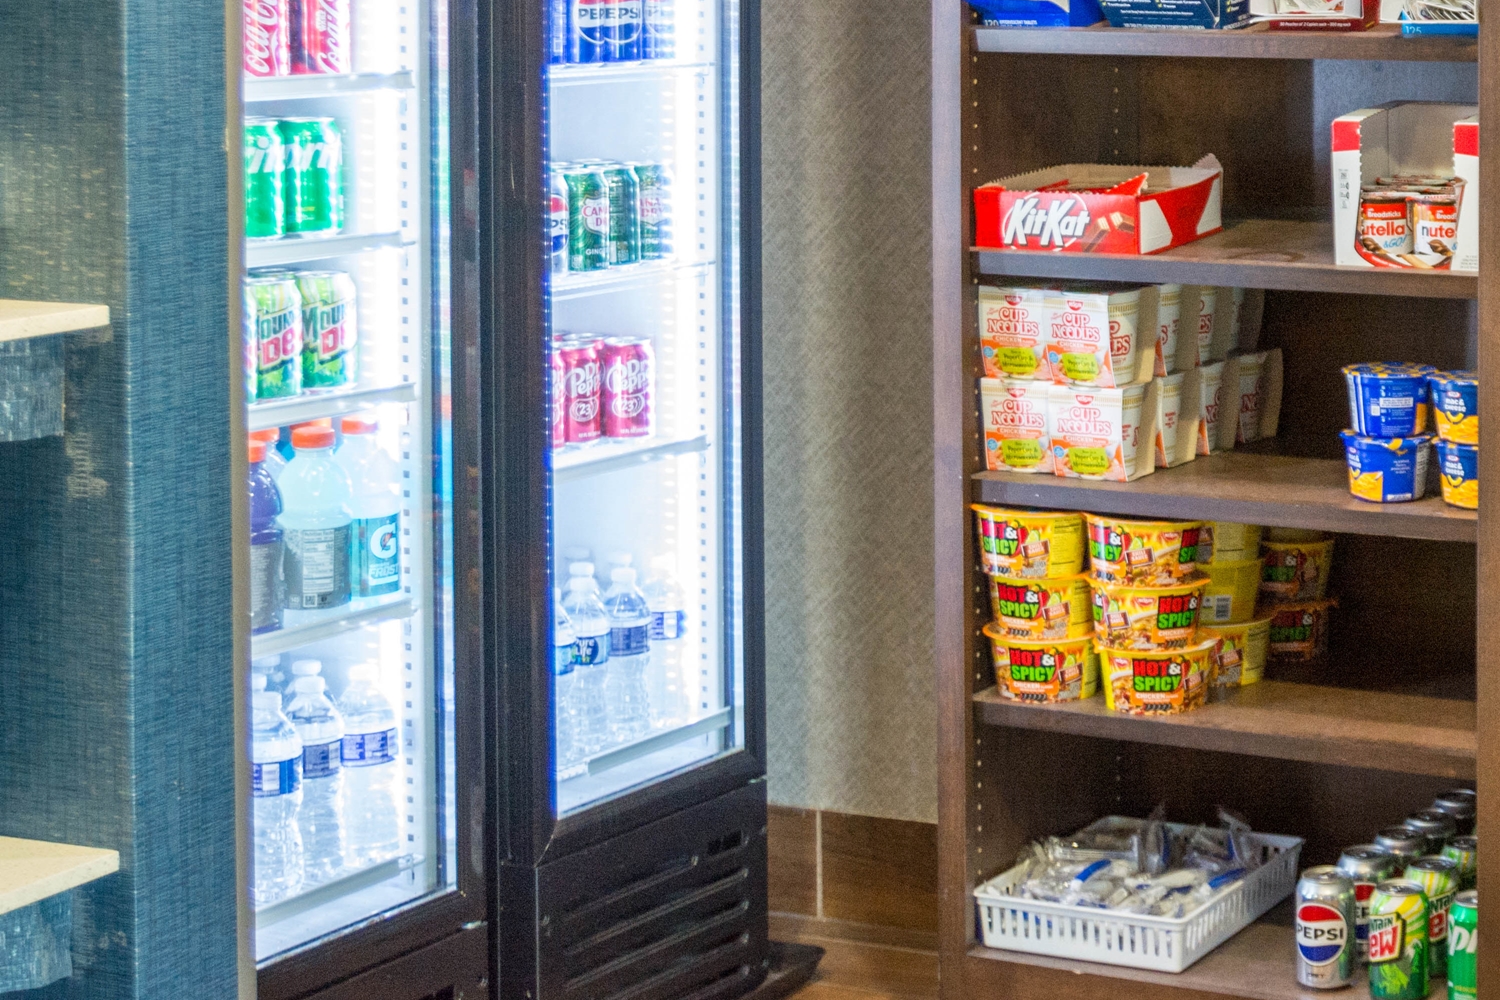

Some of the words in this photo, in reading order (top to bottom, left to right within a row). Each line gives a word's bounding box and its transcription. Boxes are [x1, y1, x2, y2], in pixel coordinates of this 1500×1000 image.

[1004, 198, 1090, 246] KitKat
[999, 307, 1028, 321] CUP
[1062, 313, 1090, 327] CUP
[987, 319, 1039, 336] NOODLES
[1052, 324, 1100, 342] NOODLES
[1009, 648, 1043, 667] HOT
[1041, 654, 1055, 666] &
[1011, 665, 1055, 682] SPICY
[1133, 660, 1171, 677] HOT
[1169, 662, 1181, 675] &
[1134, 675, 1182, 691] SPICY
[1298, 926, 1344, 941] PEPSI
